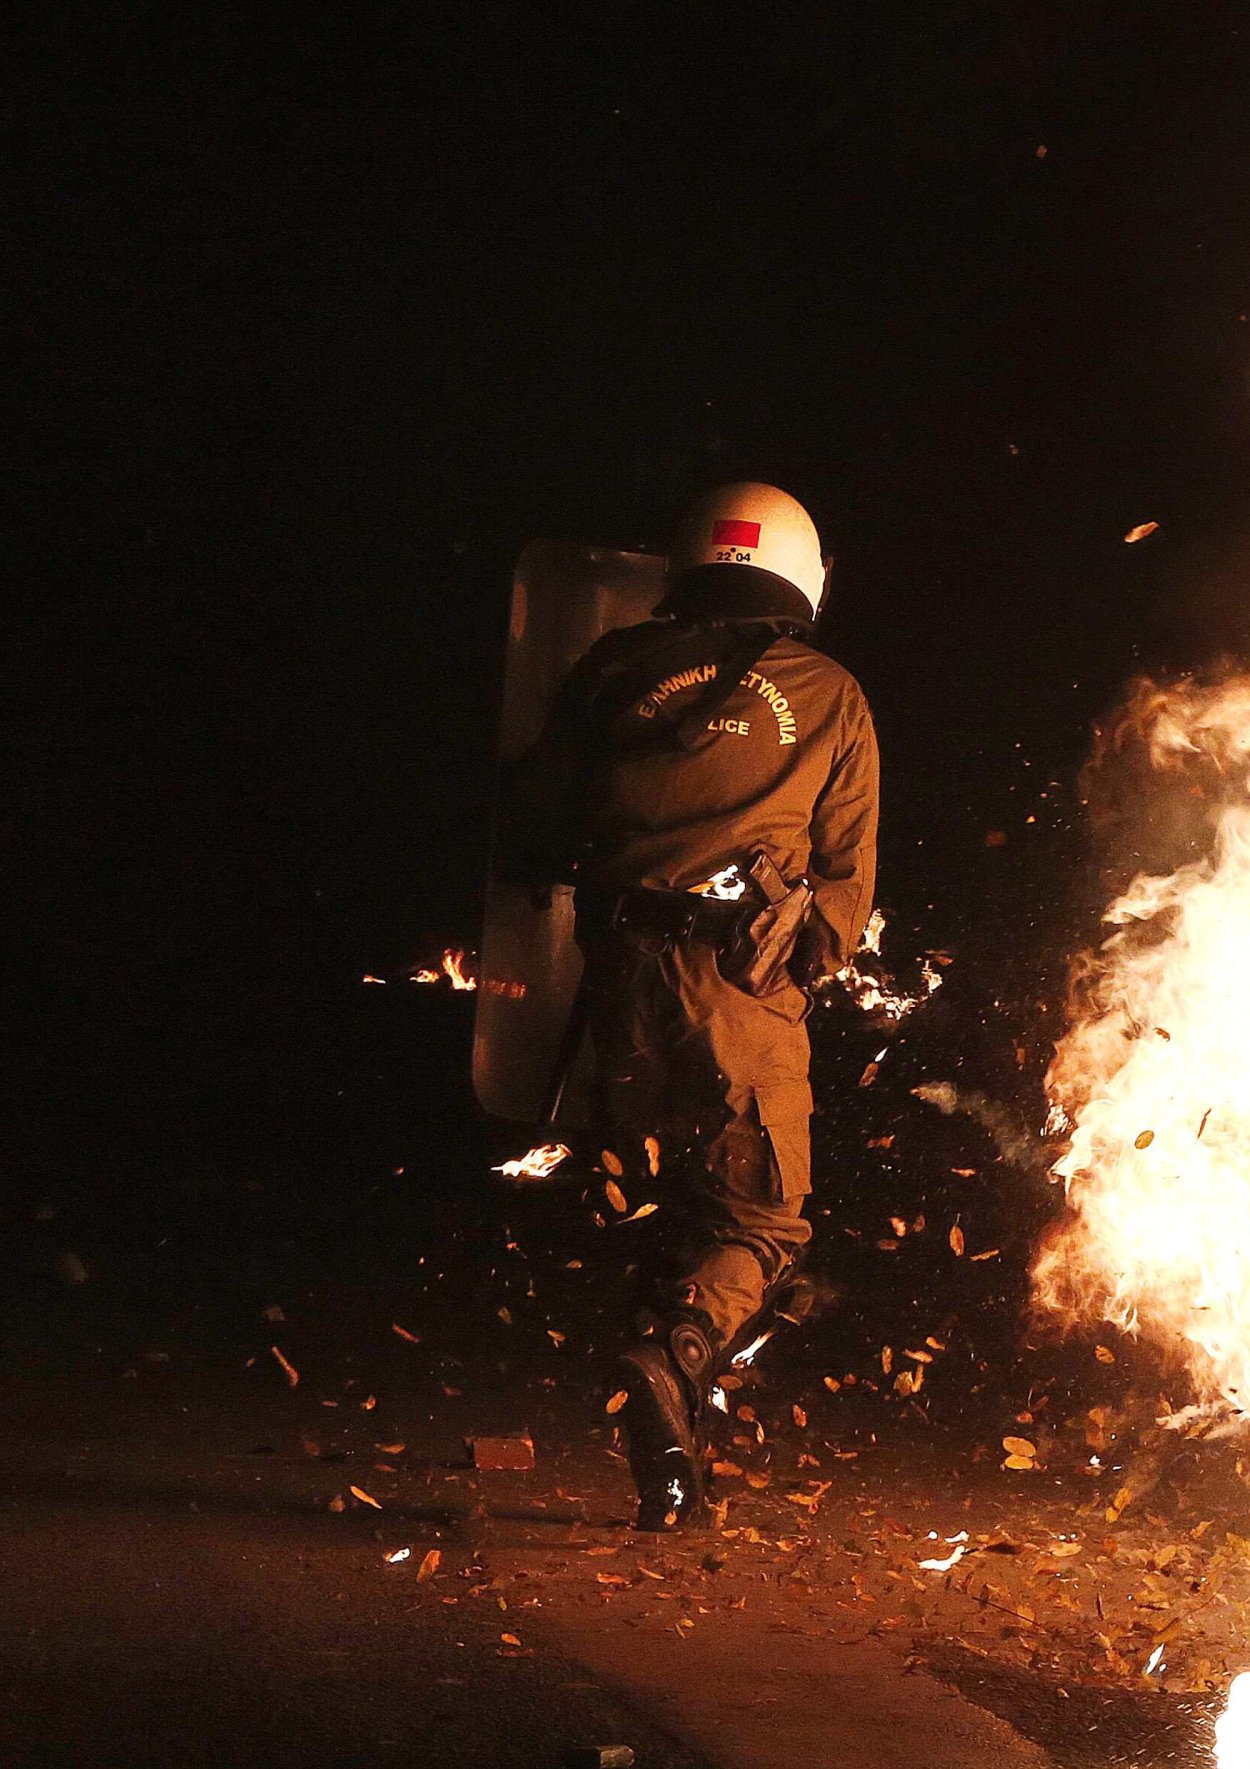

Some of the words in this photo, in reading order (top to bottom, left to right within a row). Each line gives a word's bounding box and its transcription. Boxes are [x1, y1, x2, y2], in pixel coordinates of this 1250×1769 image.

[716, 551, 731, 561] 22
[736, 553, 751, 562] 04
[739, 670, 797, 746] ΤΥΝΟΜΙΑ
[707, 718, 751, 736] LICE
